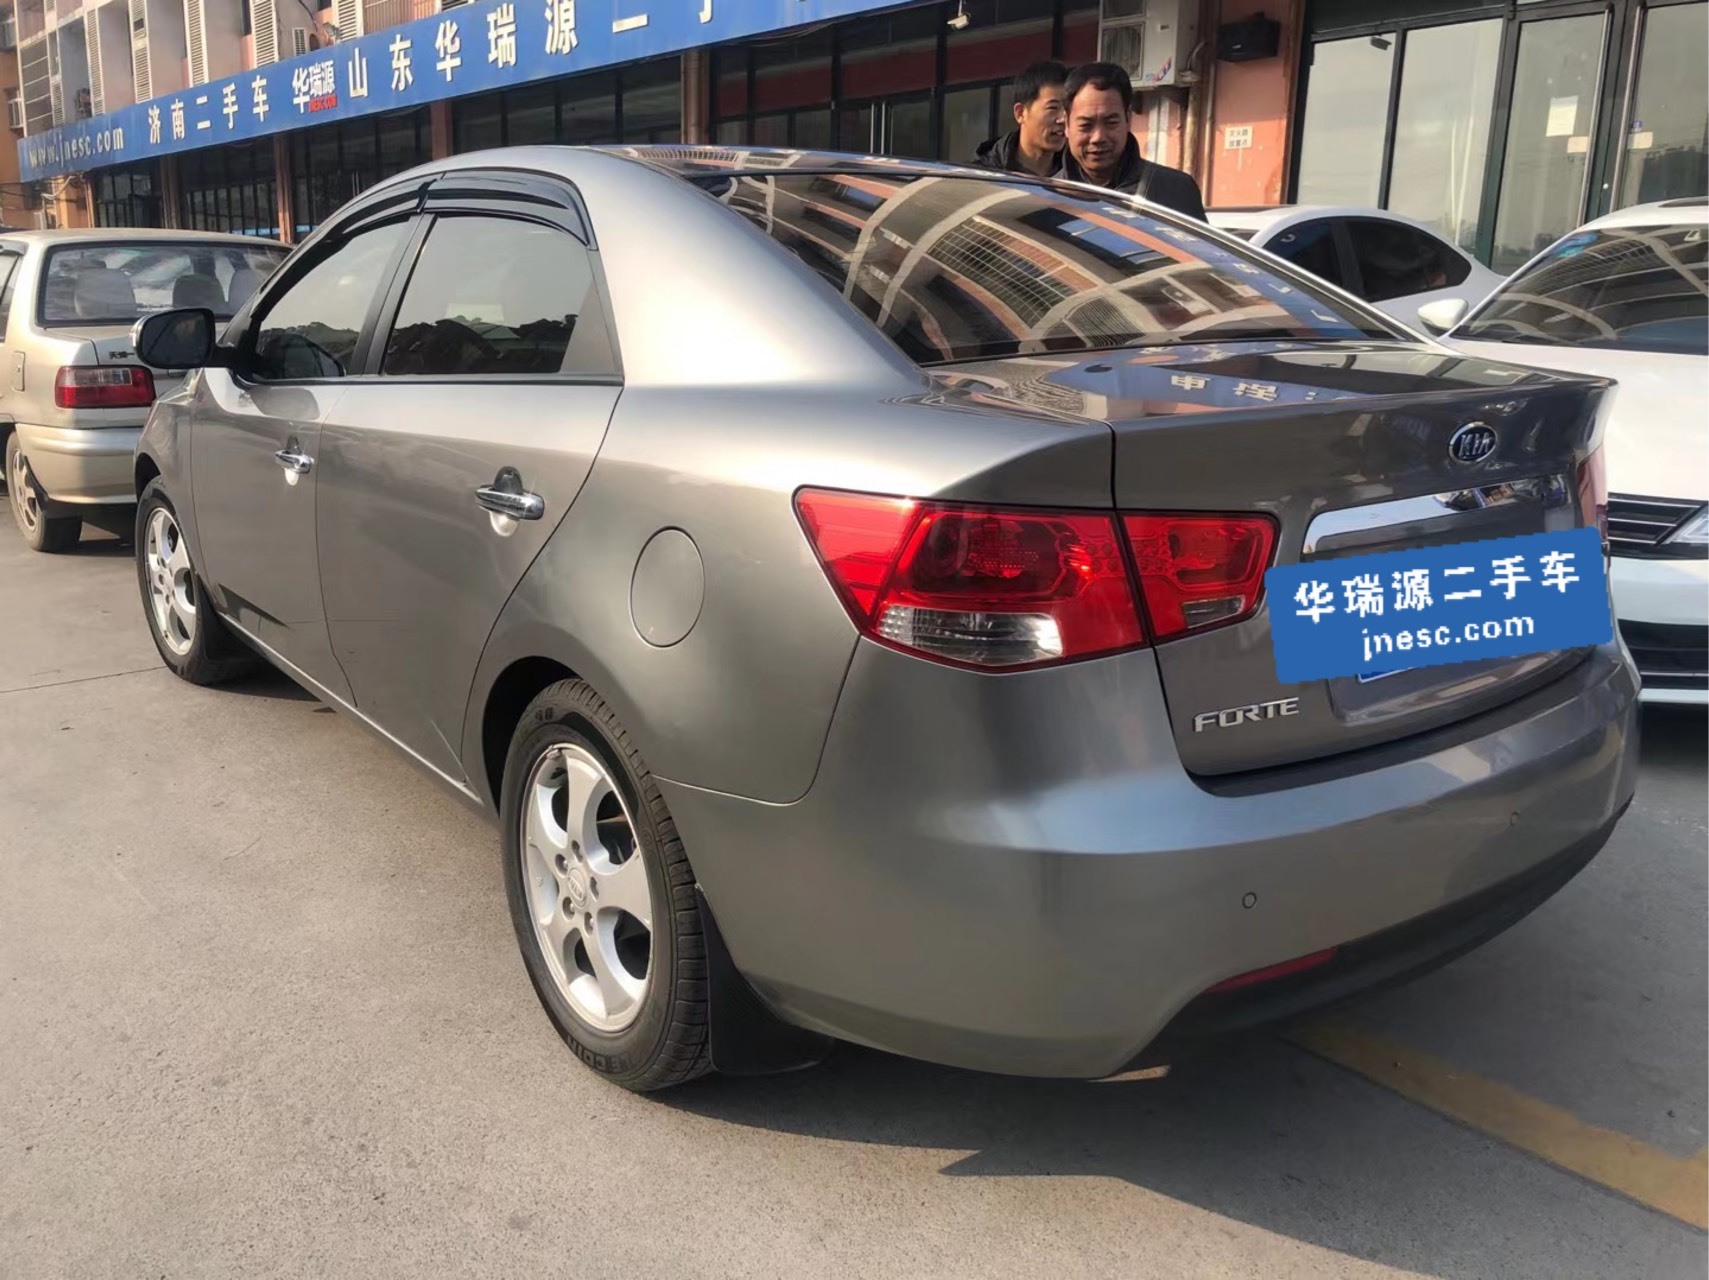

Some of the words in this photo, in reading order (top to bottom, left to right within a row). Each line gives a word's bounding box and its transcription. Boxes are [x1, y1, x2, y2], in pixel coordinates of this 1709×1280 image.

[29, 127, 124, 168] www.jnesc.com
[148, 74, 269, 144] 济南二手车
[292, 60, 336, 113] 华瑞源
[1458, 432, 1492, 456] KIA
[1193, 697, 1299, 732] FORTE
